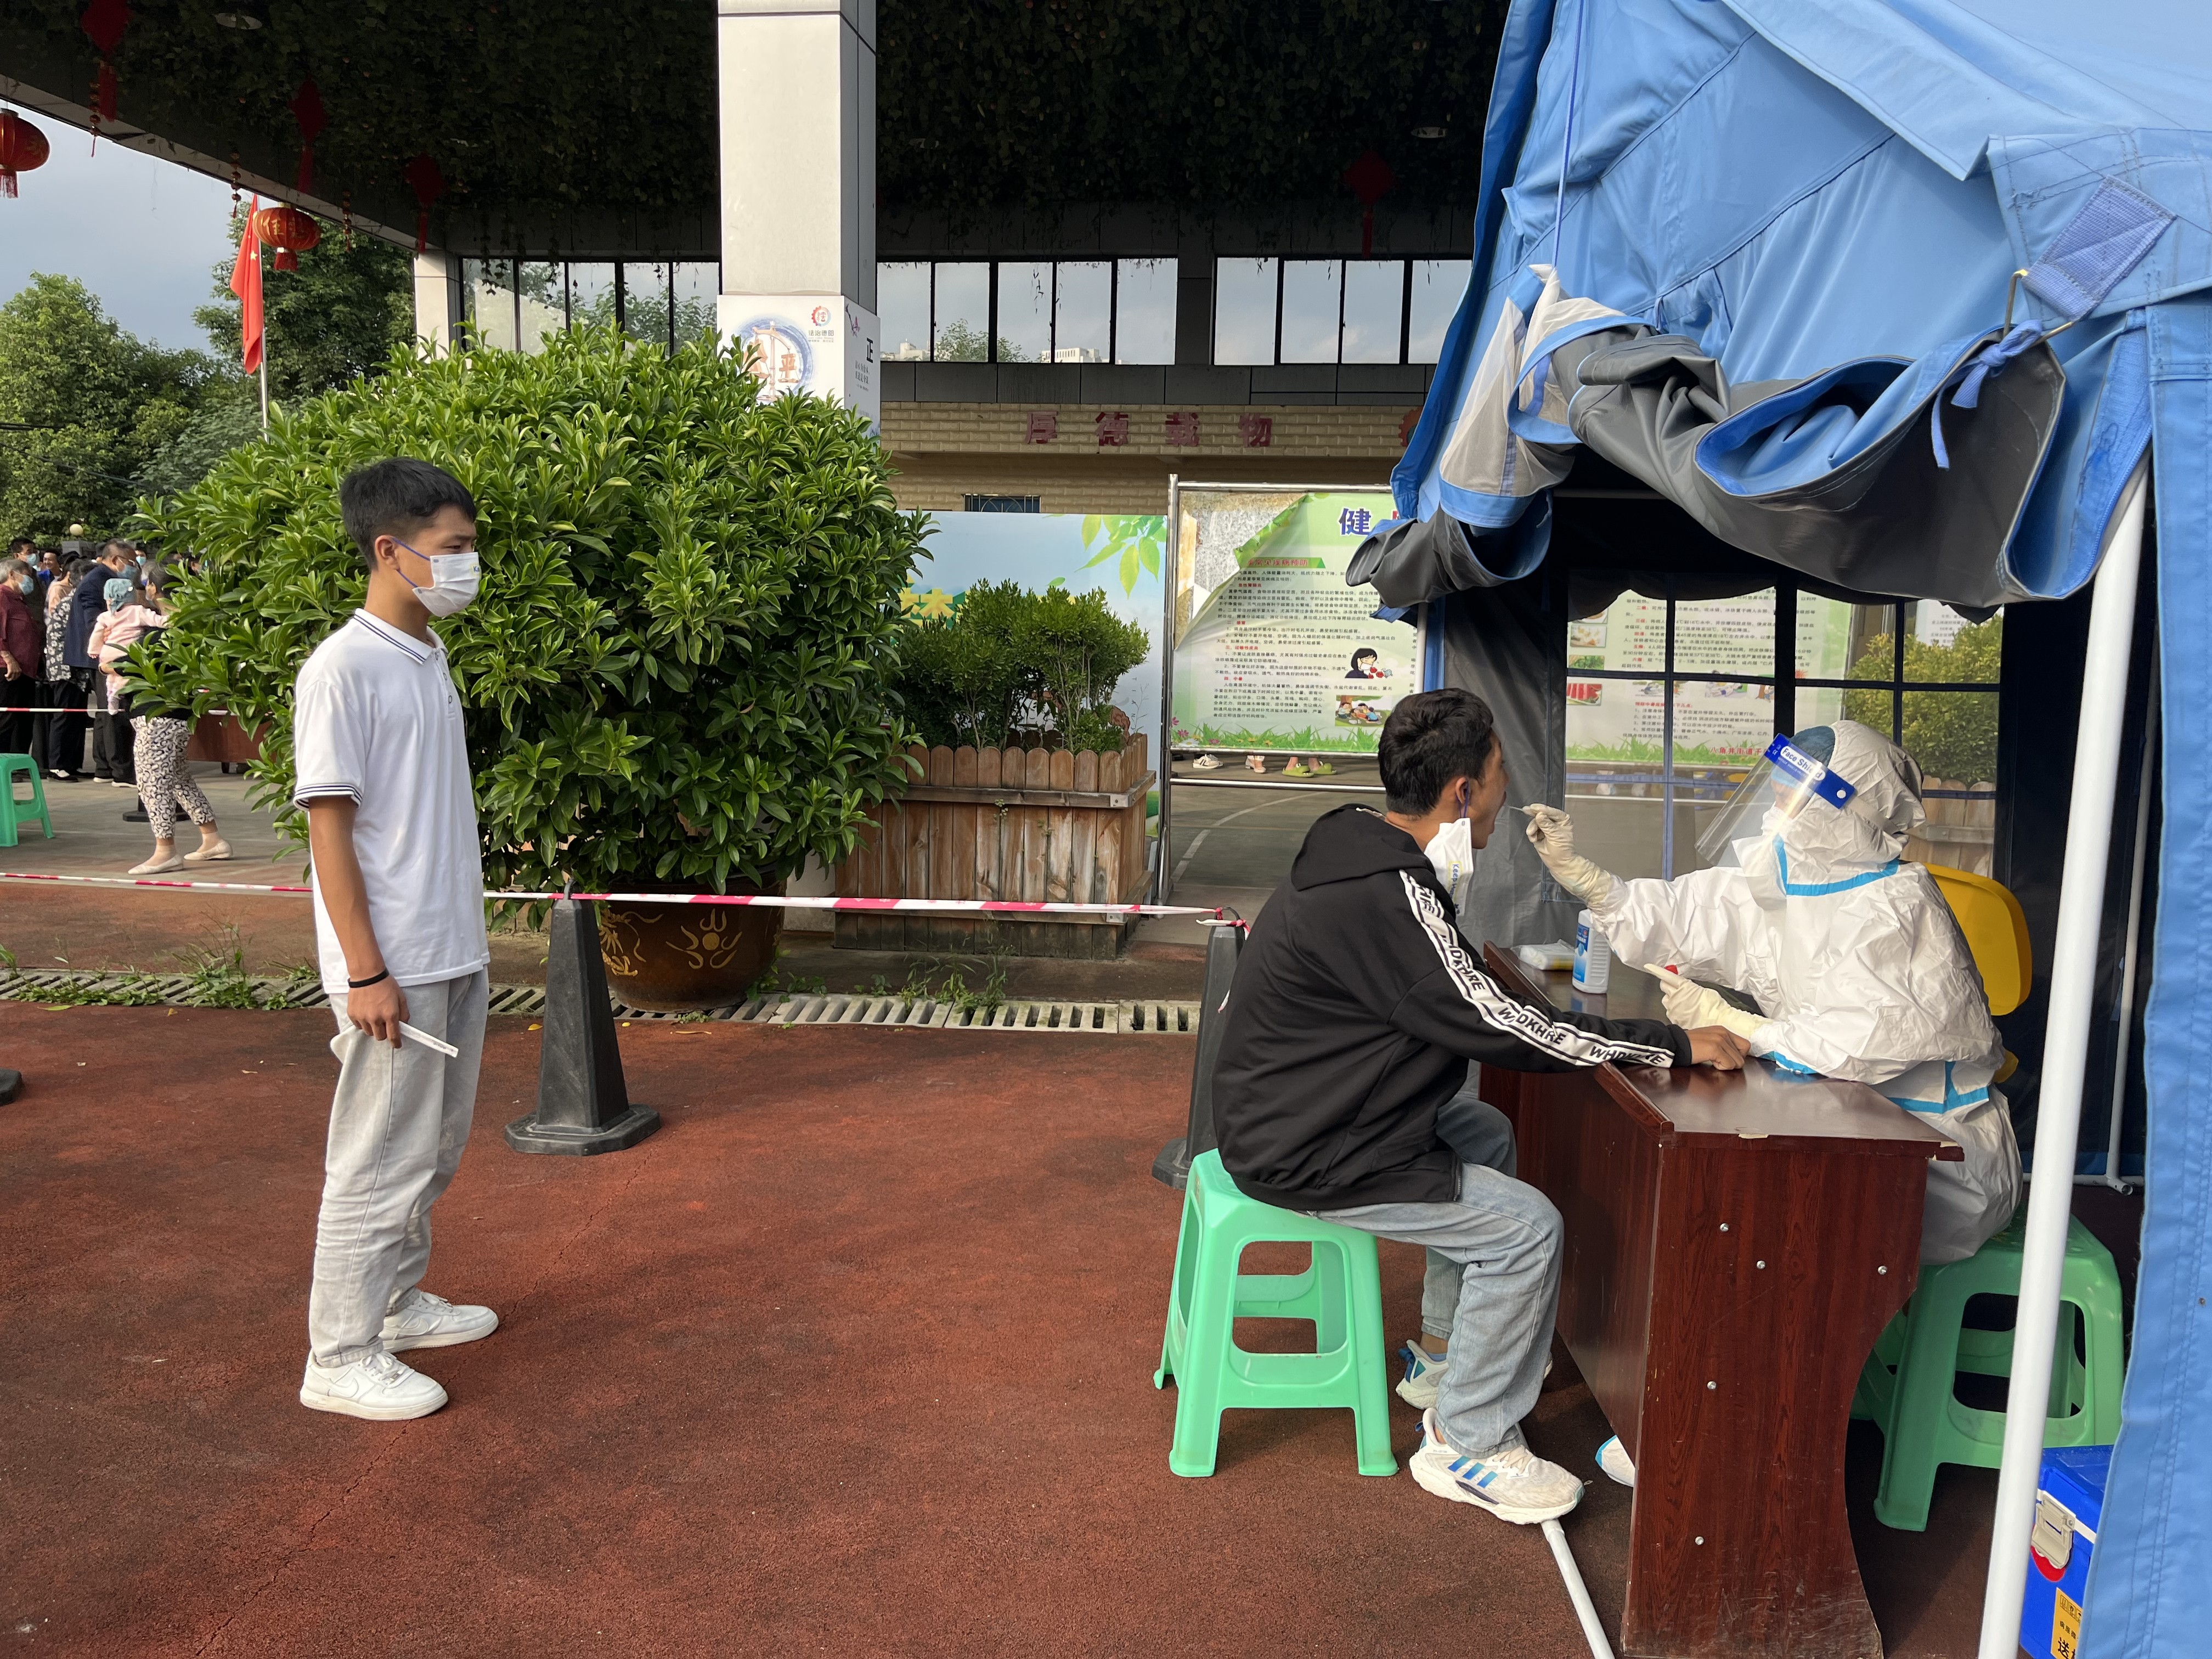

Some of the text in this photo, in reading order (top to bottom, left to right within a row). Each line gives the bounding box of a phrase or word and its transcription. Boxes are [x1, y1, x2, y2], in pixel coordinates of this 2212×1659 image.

[866, 337, 873, 363] 正
[1026, 410, 1272, 448] 厚德载物
[1339, 507, 1372, 535] 健
[1710, 746, 1766, 756] 八角井街道千
[1782, 747, 1798, 762] Face
[1797, 759, 1823, 779] Shid
[1451, 864, 1460, 882] Keep
[1497, 1007, 1567, 1046] WDKHRE
